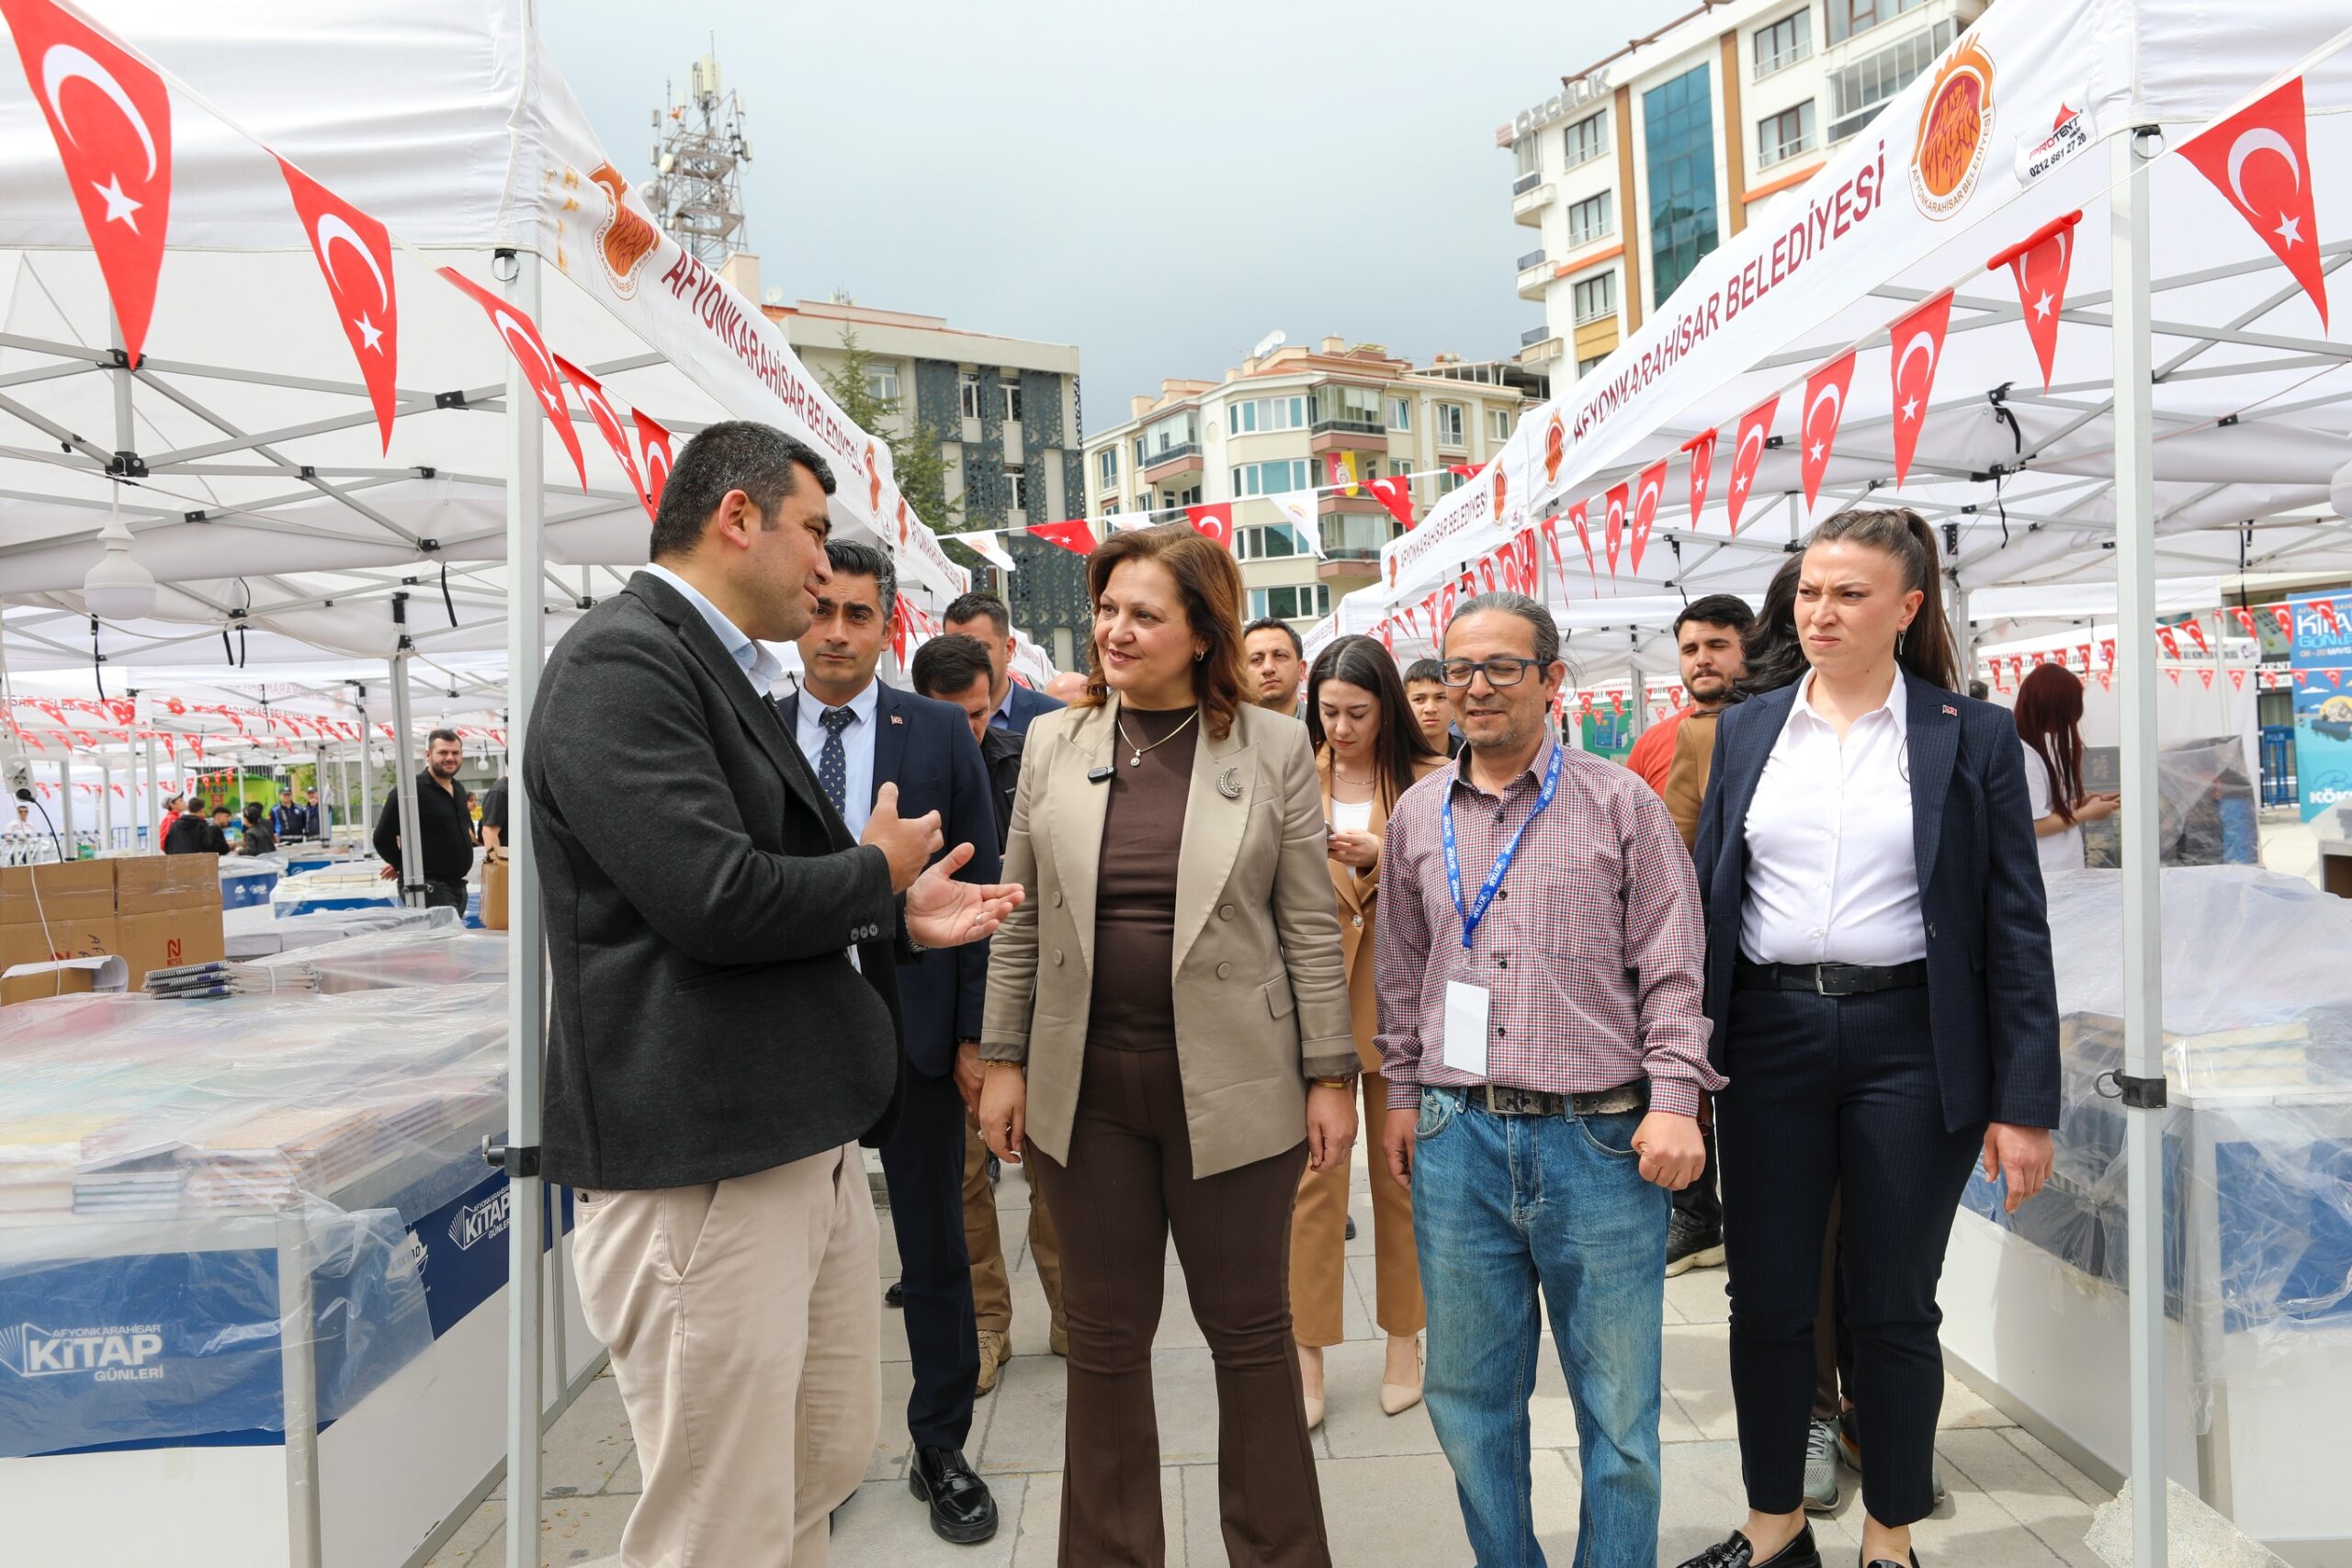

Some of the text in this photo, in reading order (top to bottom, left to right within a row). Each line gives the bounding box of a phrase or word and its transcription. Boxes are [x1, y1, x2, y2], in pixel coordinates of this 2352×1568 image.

[2029, 114, 2080, 161] PROTENT
[2029, 158, 2050, 177] 0212
[2066, 139, 2075, 154] 27
[2076, 132, 2086, 147] 20
[1573, 139, 1885, 446] AFYONKARAHİSAR BELEDİYESİ
[661, 248, 865, 479] AFYONKARAHİSAR BELEDİYESİ
[2299, 632, 2352, 649] GÜNLE
[465, 1191, 510, 1244] KİTAP
[29, 1333, 164, 1372] KİTAP
[52, 1323, 162, 1339] AFYONKARAHİSAR
[94, 1364, 164, 1382] GÜNLERİ
